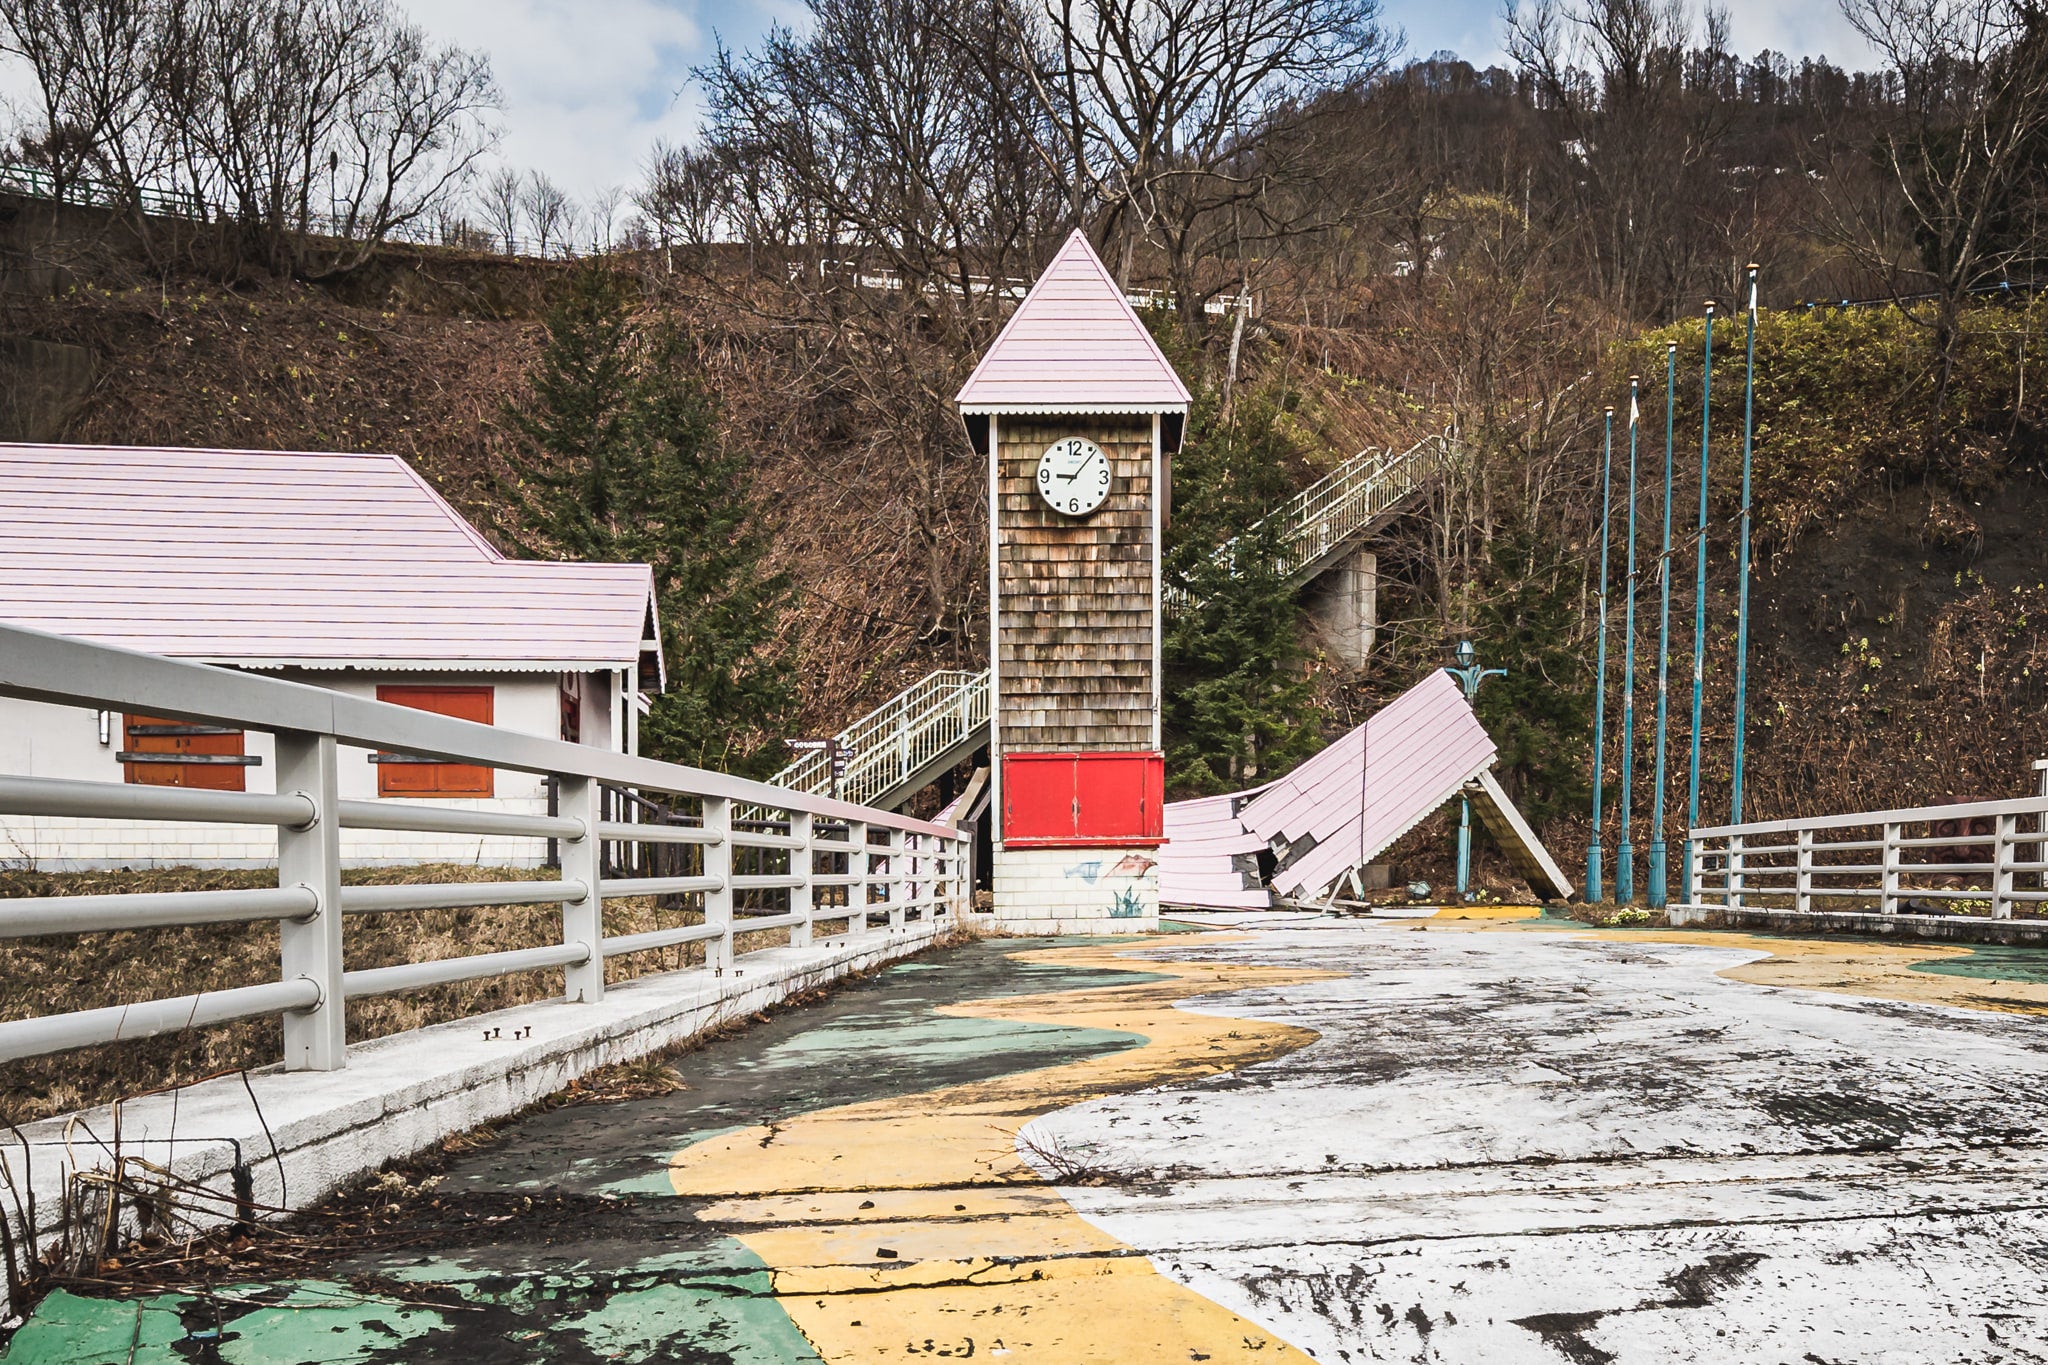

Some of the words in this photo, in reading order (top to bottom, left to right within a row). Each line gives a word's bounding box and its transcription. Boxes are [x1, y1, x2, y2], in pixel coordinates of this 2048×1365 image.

[1067, 440, 1082, 456] 12
[1040, 469, 1050, 483] 9
[1099, 470, 1109, 484] 3
[1069, 498, 1079, 512] 6
